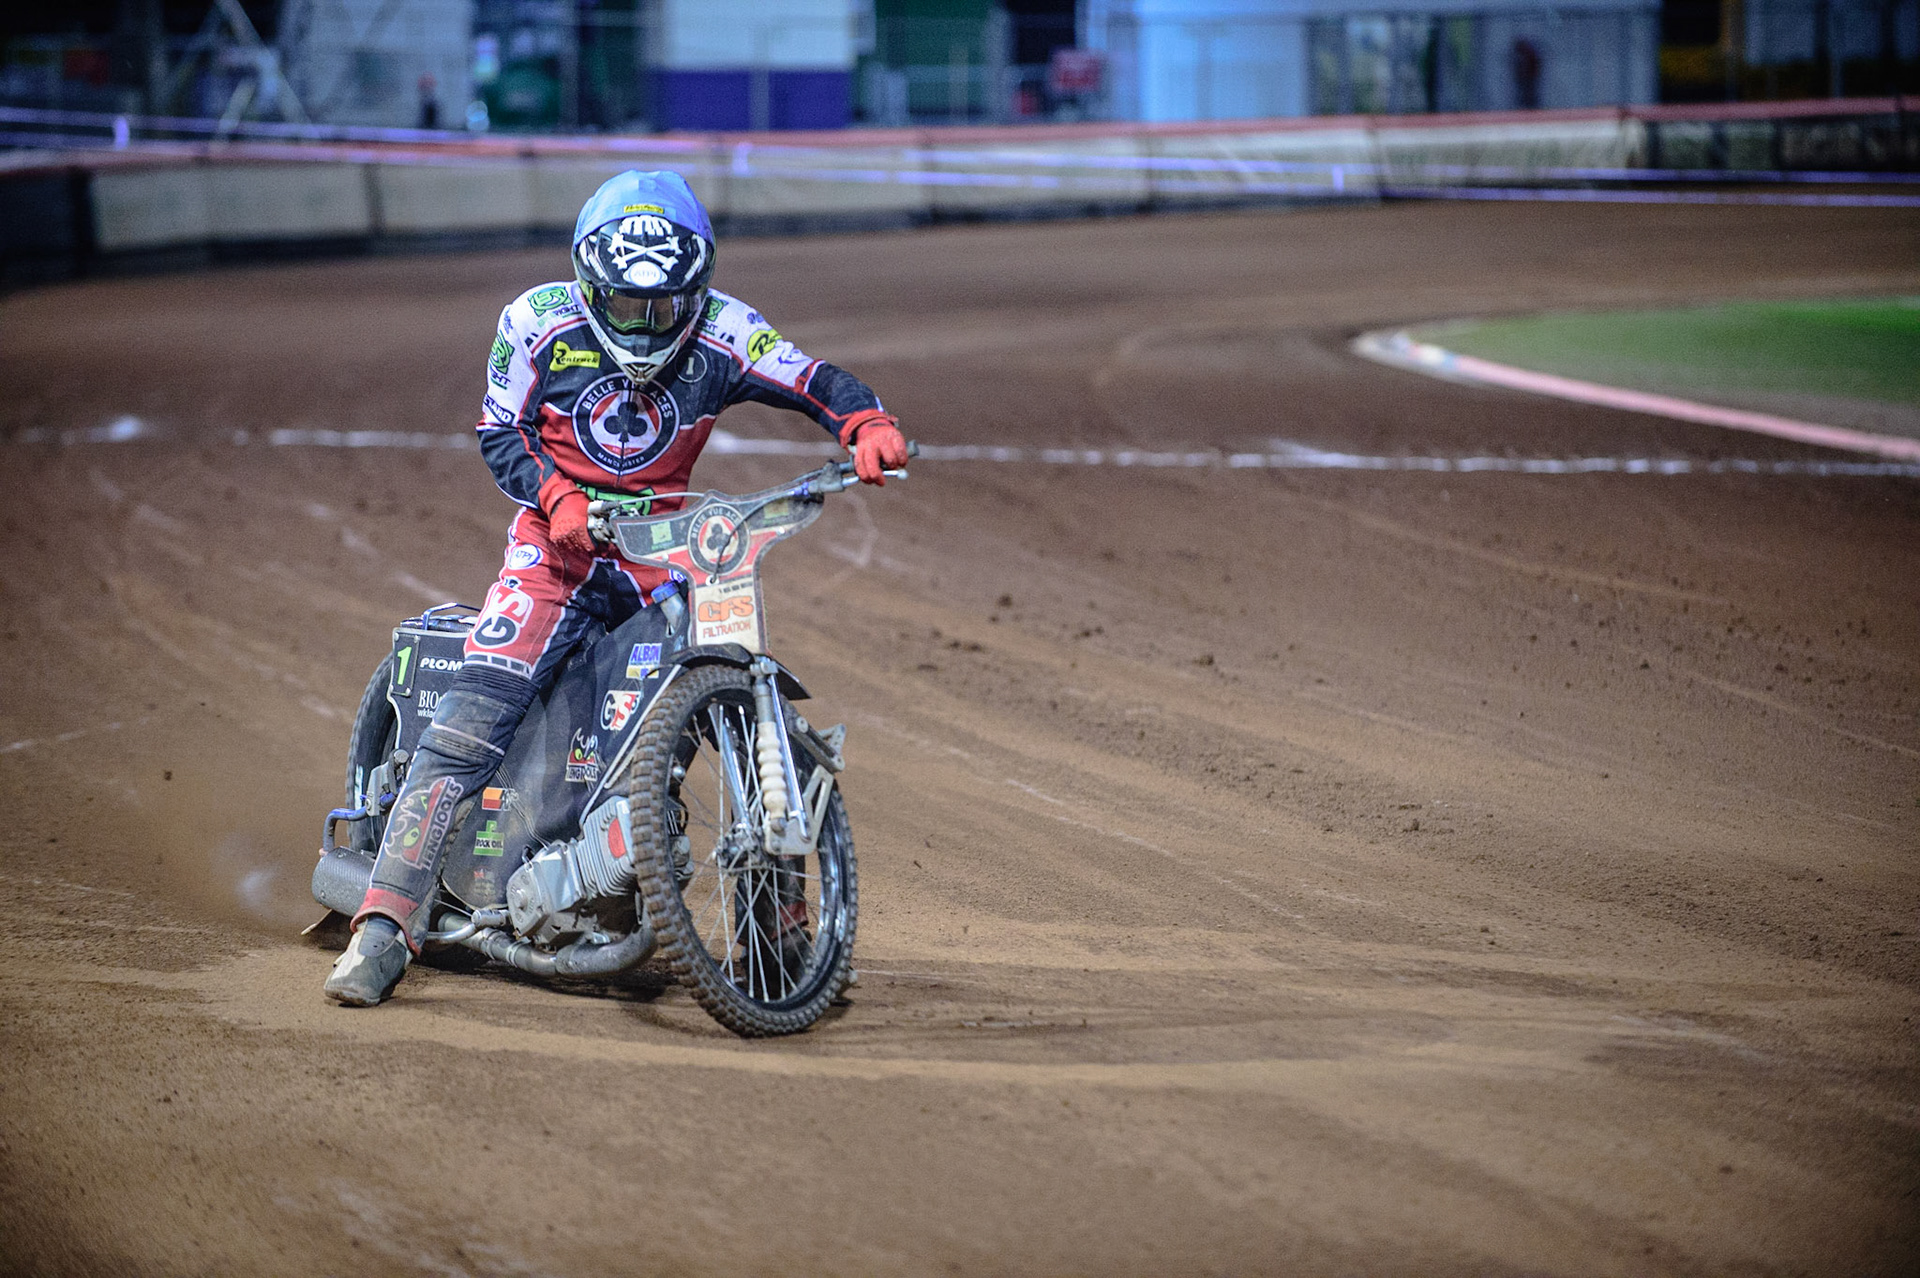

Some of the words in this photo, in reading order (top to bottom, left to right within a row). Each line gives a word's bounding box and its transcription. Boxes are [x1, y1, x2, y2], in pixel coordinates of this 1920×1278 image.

[581, 380, 616, 411] BELLE
[650, 390, 673, 418] ACES
[708, 506, 725, 516] VUE
[698, 595, 755, 623] CFS
[703, 621, 750, 638] FILTRATION
[397, 646, 412, 685] 1
